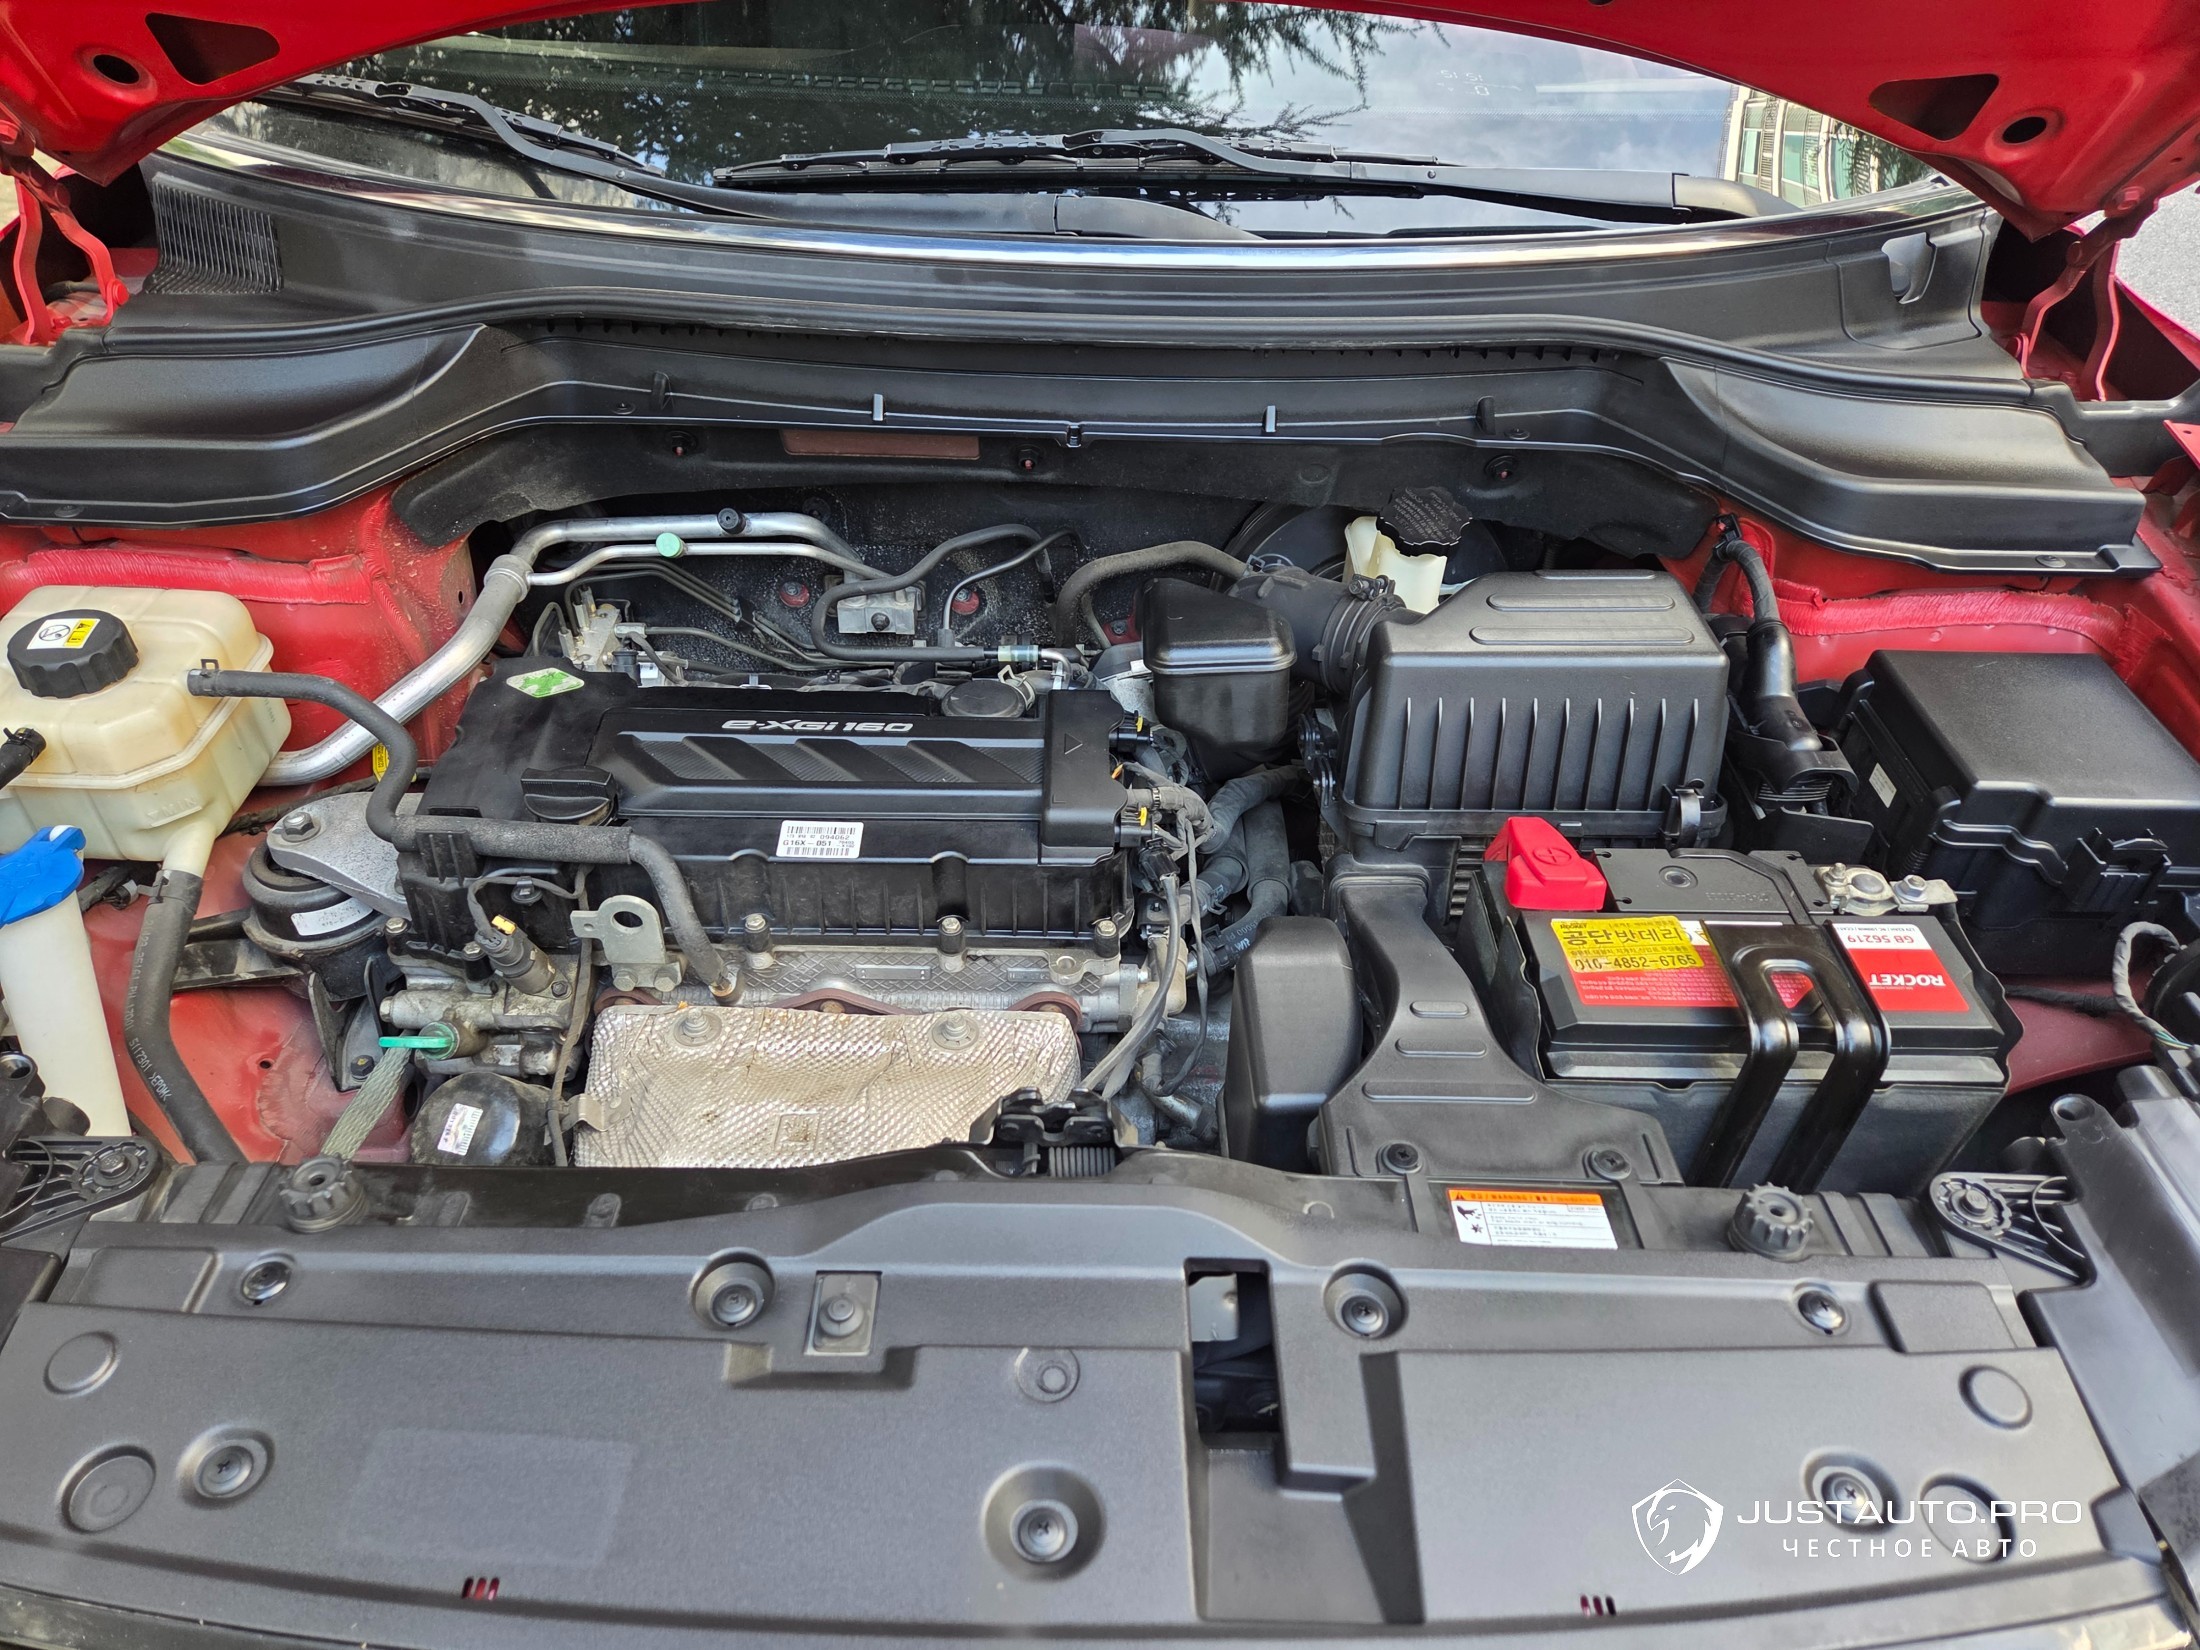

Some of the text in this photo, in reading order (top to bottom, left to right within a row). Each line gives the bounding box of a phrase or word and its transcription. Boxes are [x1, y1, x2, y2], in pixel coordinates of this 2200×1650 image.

[842, 722, 914, 733] 160
[1847, 934, 1892, 943] 56219
[1869, 974, 1946, 986] ROCKET
